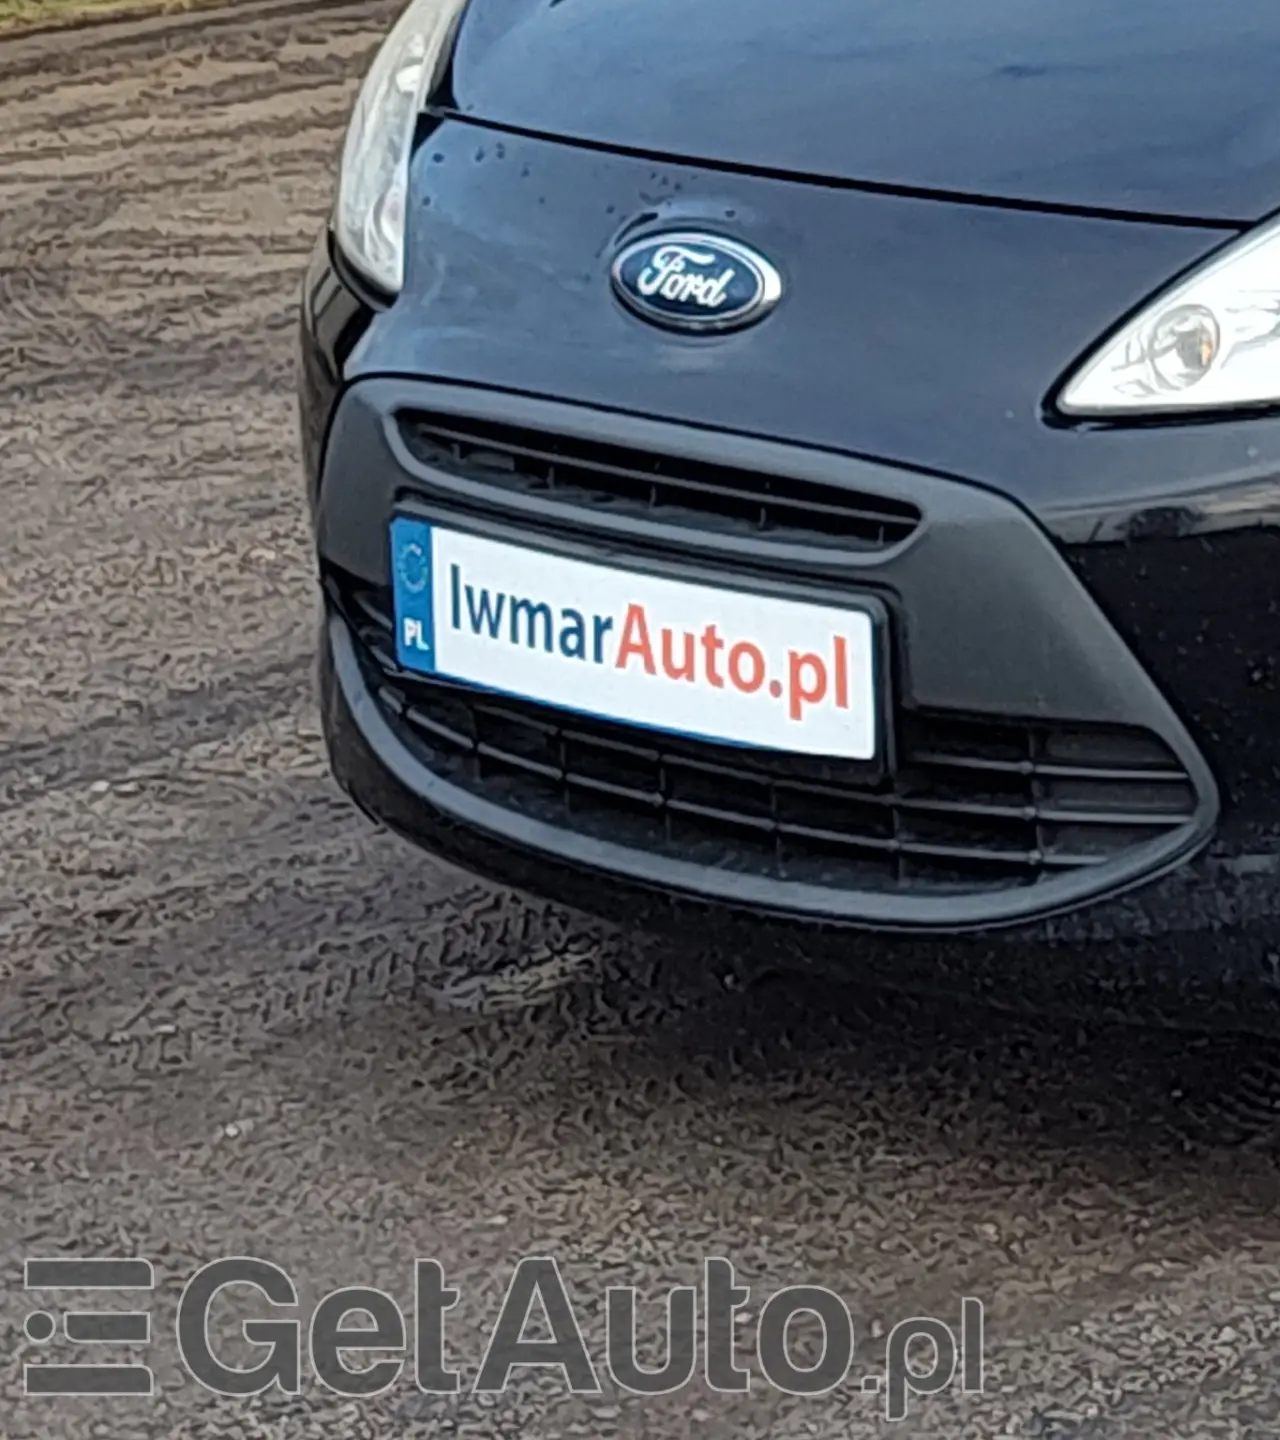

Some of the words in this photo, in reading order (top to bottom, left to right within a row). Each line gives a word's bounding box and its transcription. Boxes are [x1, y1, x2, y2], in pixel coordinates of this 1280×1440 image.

[636, 245, 736, 308] Ford
[403, 616, 430, 651] PL
[449, 562, 849, 721] IwmarAuto.pl
